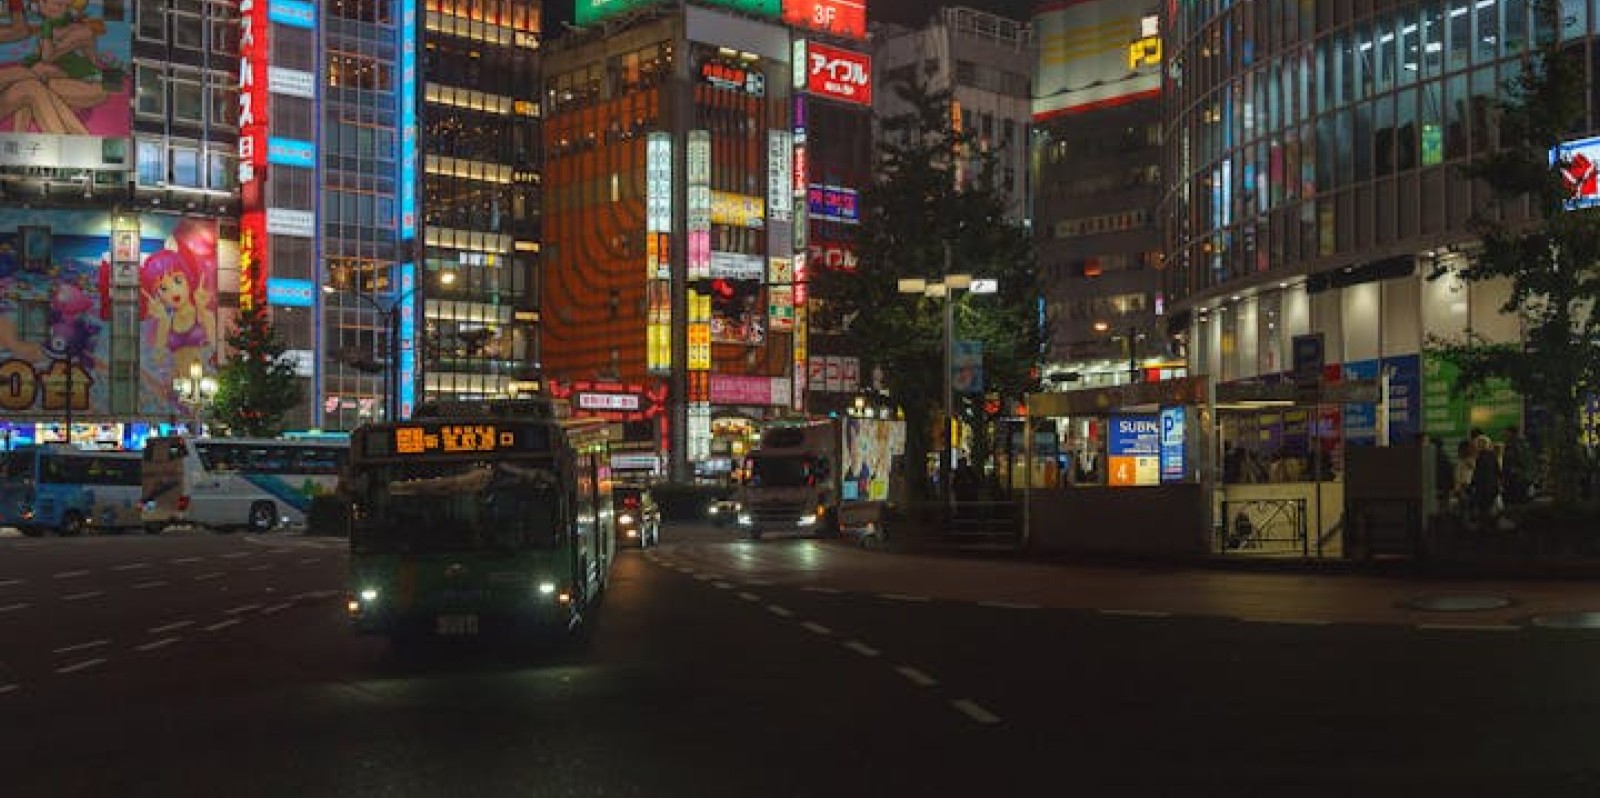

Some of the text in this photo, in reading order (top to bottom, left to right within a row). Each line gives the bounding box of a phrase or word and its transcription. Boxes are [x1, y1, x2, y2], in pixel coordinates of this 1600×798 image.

[813, 4, 836, 26] 3F
[810, 52, 867, 86] アイフル
[1164, 416, 1174, 442] P
[1117, 463, 1128, 480] 4
